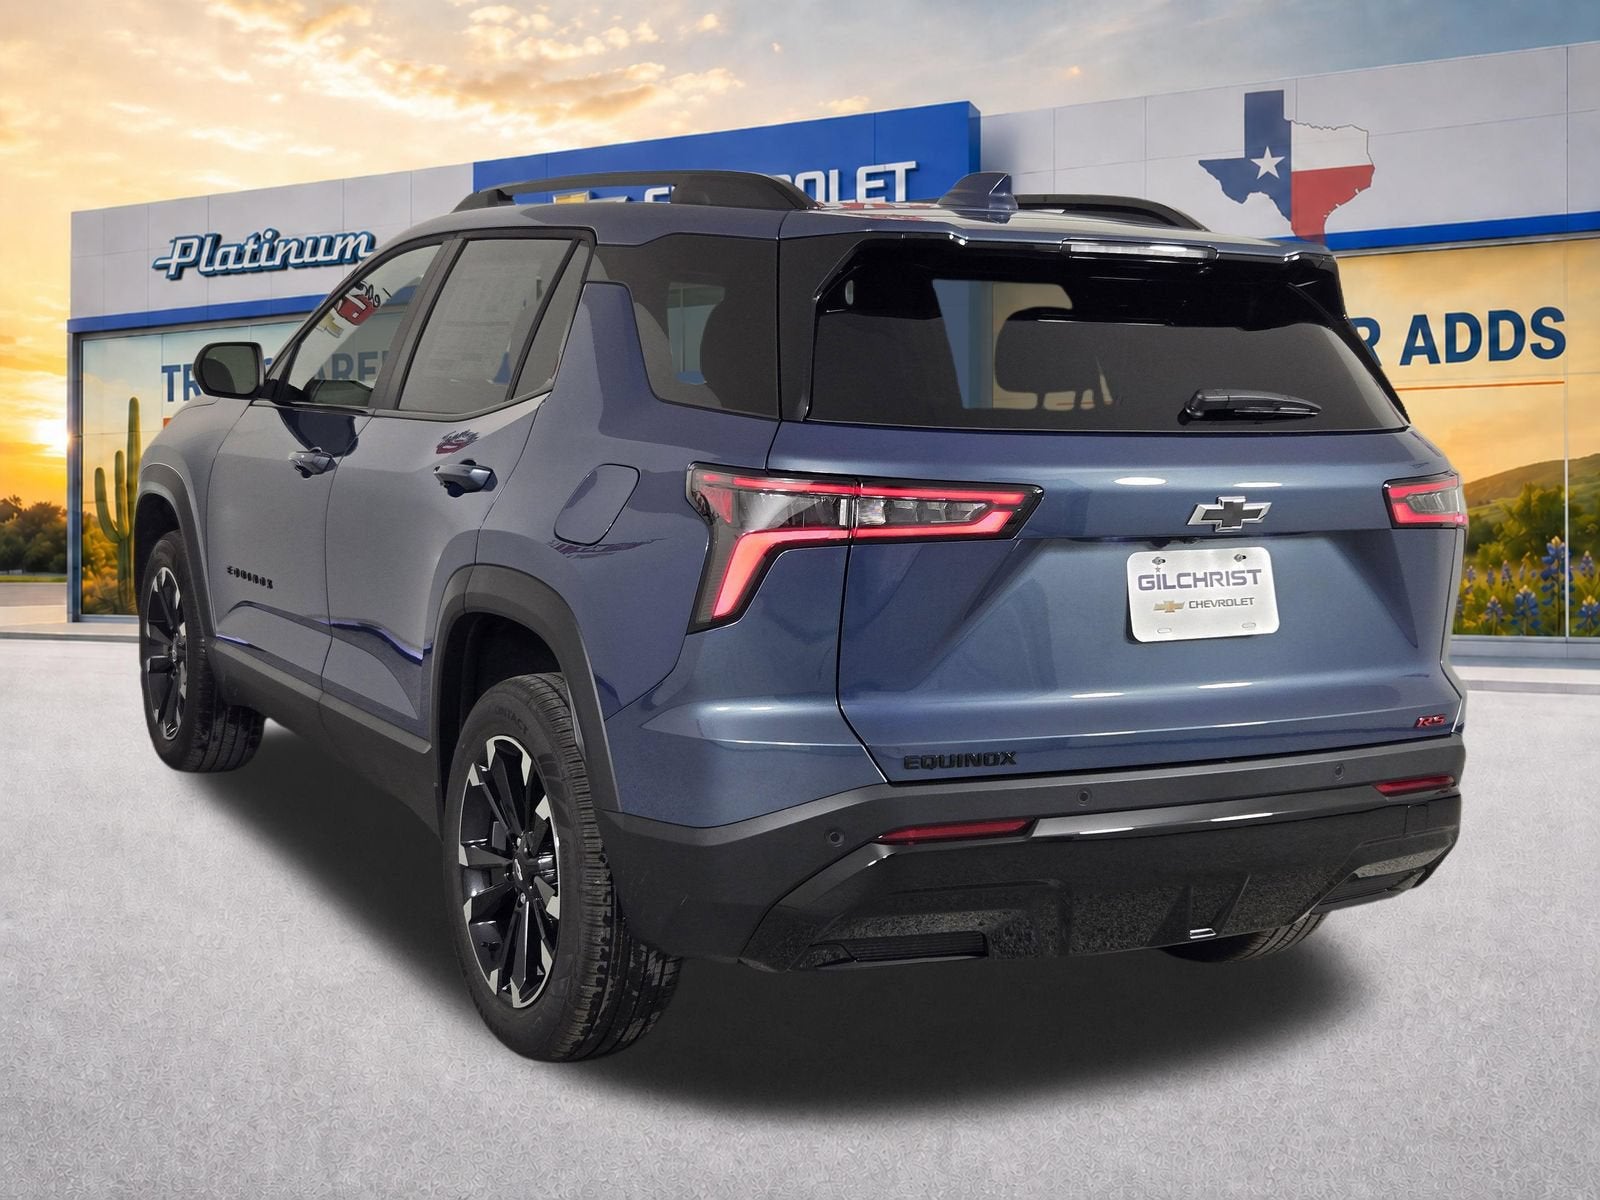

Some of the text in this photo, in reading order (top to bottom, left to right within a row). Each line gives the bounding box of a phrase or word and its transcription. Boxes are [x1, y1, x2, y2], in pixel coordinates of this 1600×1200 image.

[152, 228, 376, 281] Platinum
[1399, 306, 1567, 367] ADDS
[226, 565, 273, 590] EQUINOX
[1137, 568, 1262, 591] GILCHRIST
[1188, 597, 1255, 609] CHEVROLET
[1414, 713, 1448, 729] RS
[903, 751, 1017, 770] EQUINOX
